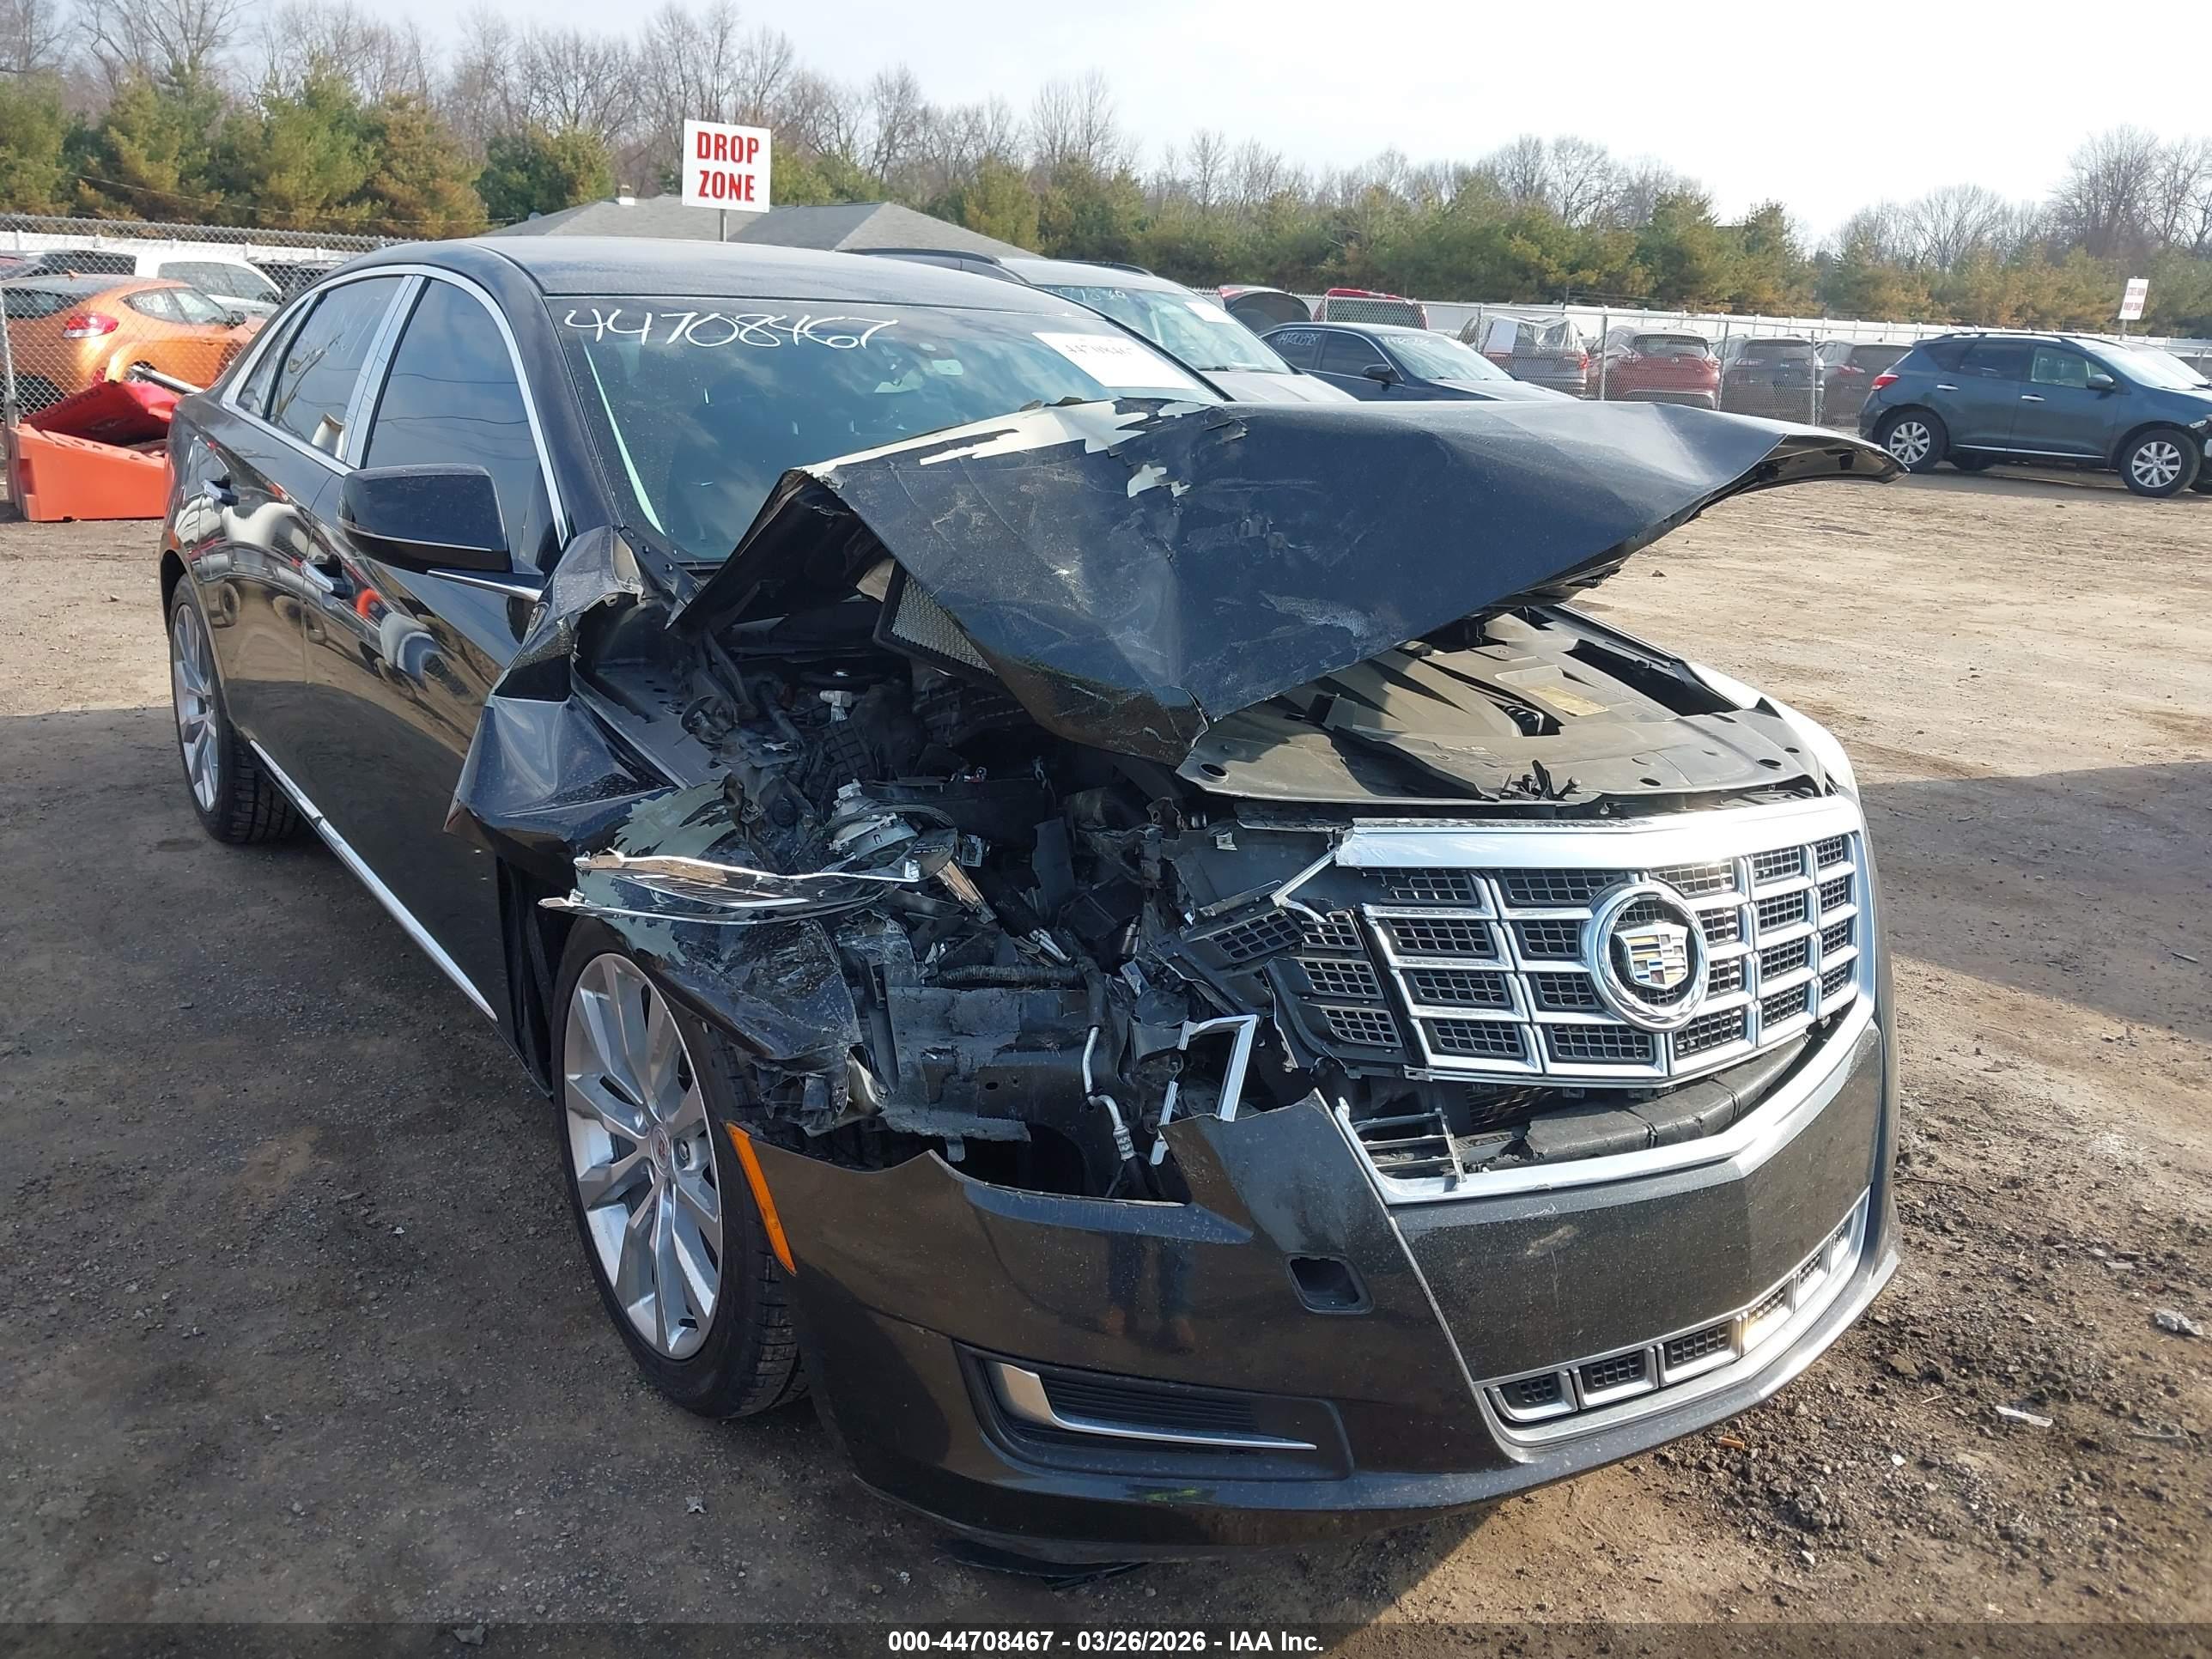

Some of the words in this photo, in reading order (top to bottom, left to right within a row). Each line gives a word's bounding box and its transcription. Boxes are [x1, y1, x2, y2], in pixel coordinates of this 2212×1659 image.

[696, 131, 760, 164] DROP
[698, 170, 756, 202] ZONE
[563, 307, 900, 349] 44708467
